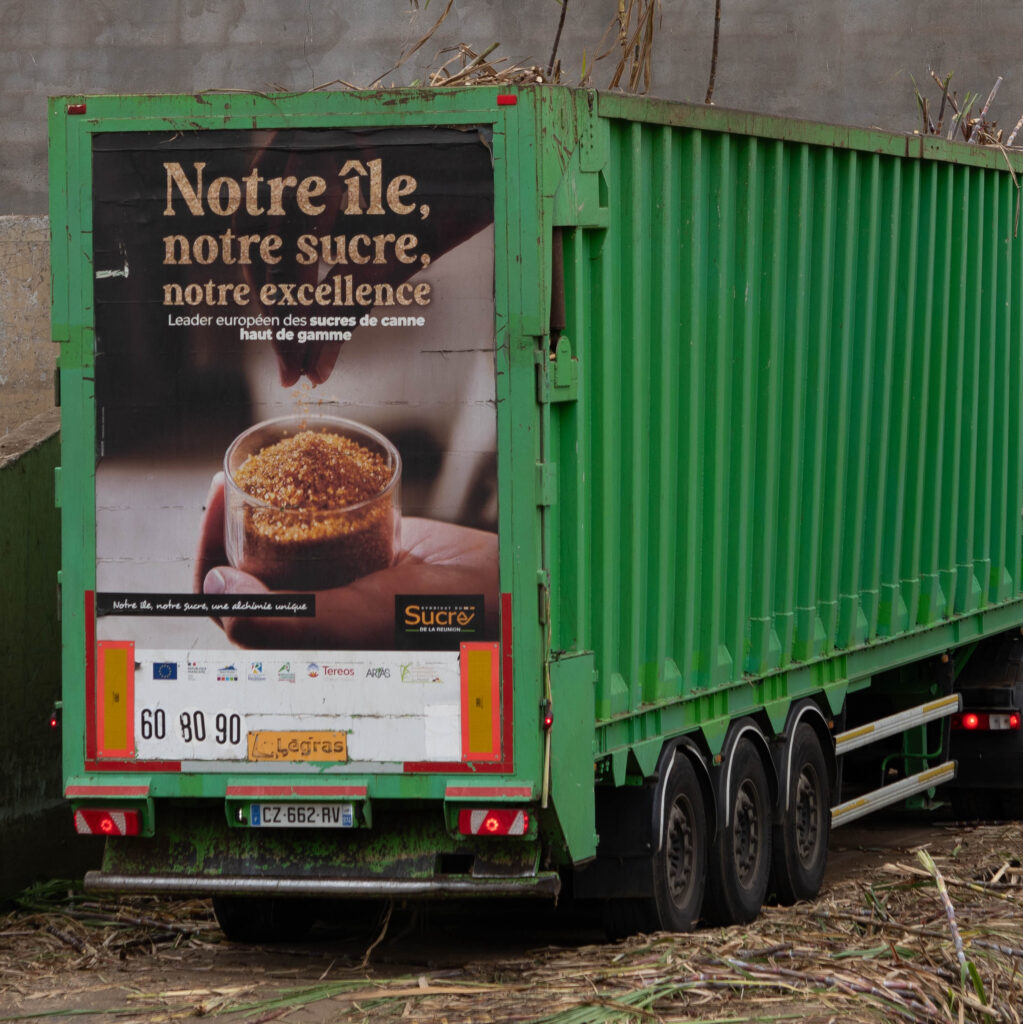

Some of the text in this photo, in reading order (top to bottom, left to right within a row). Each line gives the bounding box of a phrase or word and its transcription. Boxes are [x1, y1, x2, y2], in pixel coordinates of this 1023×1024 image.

[162, 157, 431, 221] Notre île,
[162, 227, 431, 269] notre sucre,
[162, 274, 431, 307] notre excellence
[168, 313, 426, 330] Leader européen des sucres de canne
[239, 328, 352, 343] haut de gamme
[112, 600, 138, 610] Notre
[156, 600, 181, 610] notre
[183, 602, 209, 612] sucre,
[231, 600, 273, 611] alchimie
[275, 602, 308, 613] unique
[322, 665, 355, 676] Tereos
[141, 708, 242, 745] 60 80 90
